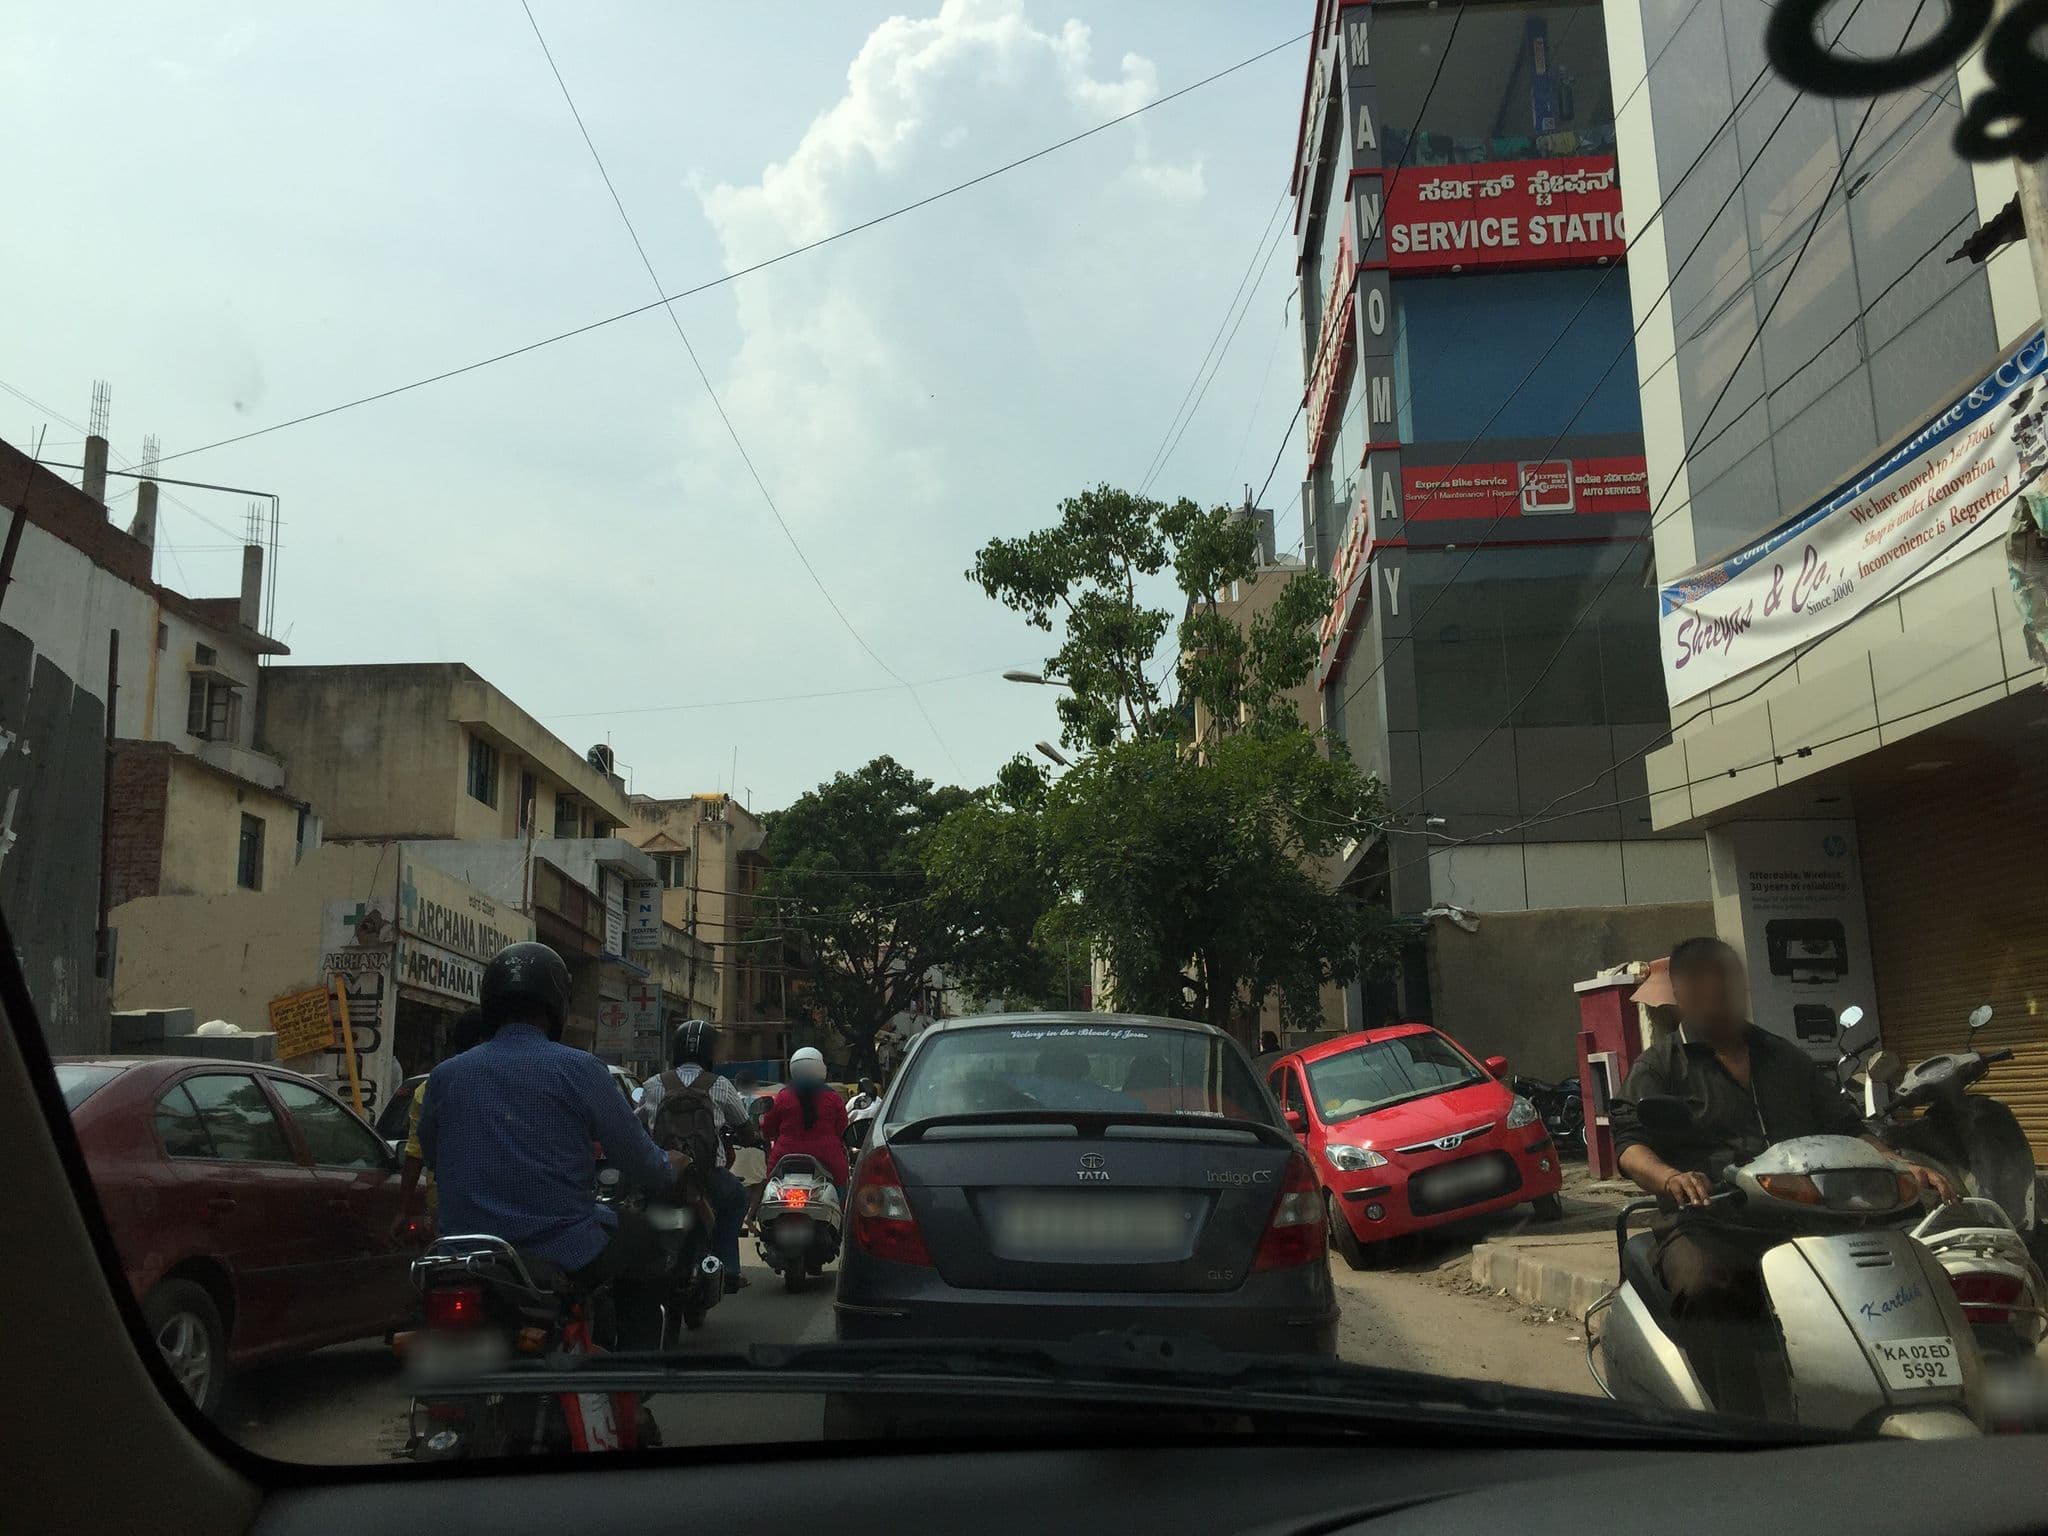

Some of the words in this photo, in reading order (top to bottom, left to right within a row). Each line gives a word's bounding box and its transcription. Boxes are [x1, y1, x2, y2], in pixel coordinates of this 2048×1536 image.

[1391, 216, 1520, 254] SERVICE
[1350, 22, 1402, 617] MANOMAY
[1452, 477, 1473, 487] Bike
[1474, 476, 1508, 486] Service
[1582, 487, 1604, 497] AUTO
[1604, 486, 1642, 496] SERVICES
[1871, 489, 1898, 516] have
[1898, 461, 1935, 499] moved
[1896, 496, 1927, 524] under
[1927, 455, 1996, 508] Renovation
[1857, 526, 1935, 580] Inconvenience
[1935, 518, 1947, 537] is
[1949, 475, 2011, 528] Regretted
[1675, 598, 1753, 670] Shreyas
[1763, 563, 1784, 617] &
[1806, 599, 1832, 616] Since
[1832, 579, 1855, 602] 2000
[417, 896, 477, 955] ARCHANA
[323, 952, 390, 970] ARCHANA
[407, 949, 475, 998] ARCHANA
[1010, 1031, 1045, 1040] Victory
[1046, 1029, 1059, 1037] in
[1059, 1028, 1077, 1036] the
[1077, 1028, 1110, 1037] Blood
[1110, 1029, 1122, 1040] of
[1121, 1029, 1149, 1040] Jesus
[1076, 1171, 1110, 1180] TATA
[1902, 1361, 1948, 1380] 5592
